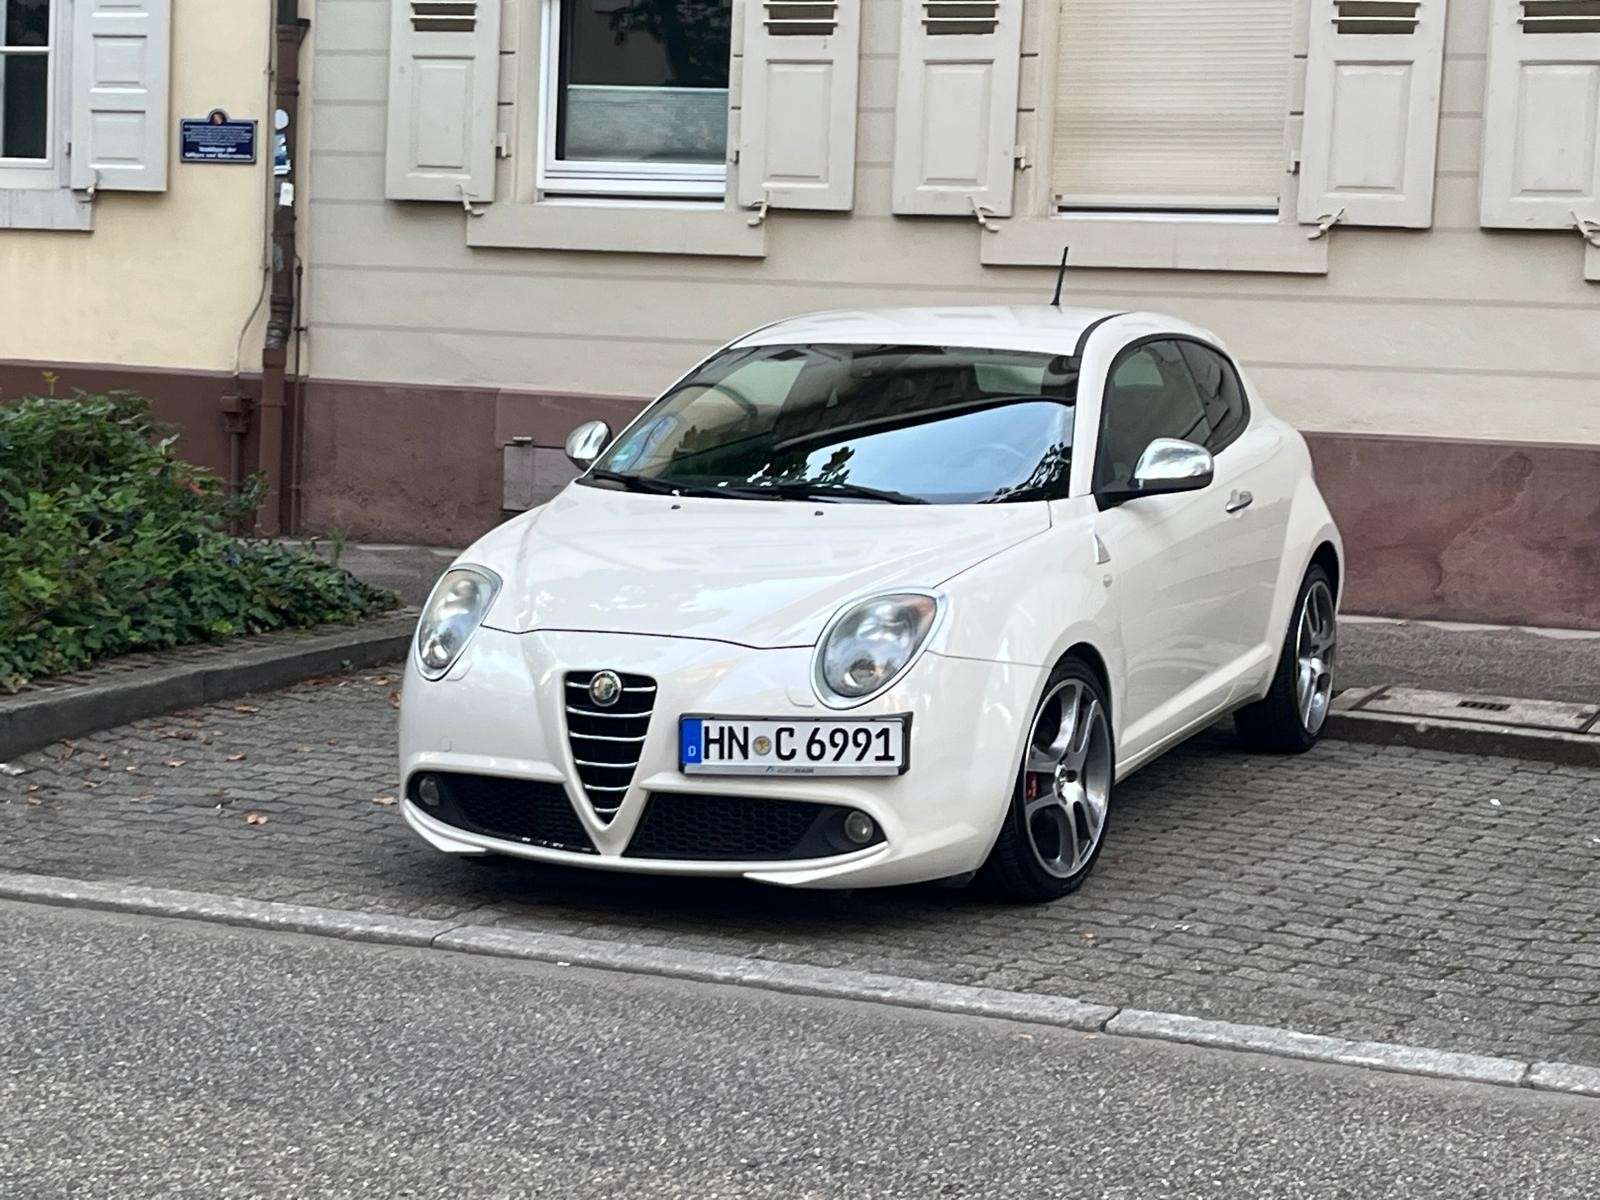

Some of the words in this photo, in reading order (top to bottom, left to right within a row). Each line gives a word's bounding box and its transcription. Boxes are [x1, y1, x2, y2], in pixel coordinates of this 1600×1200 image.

[687, 745, 697, 757] D
[703, 726, 749, 760] HN
[775, 727, 797, 761] C
[806, 727, 895, 762] 6991
